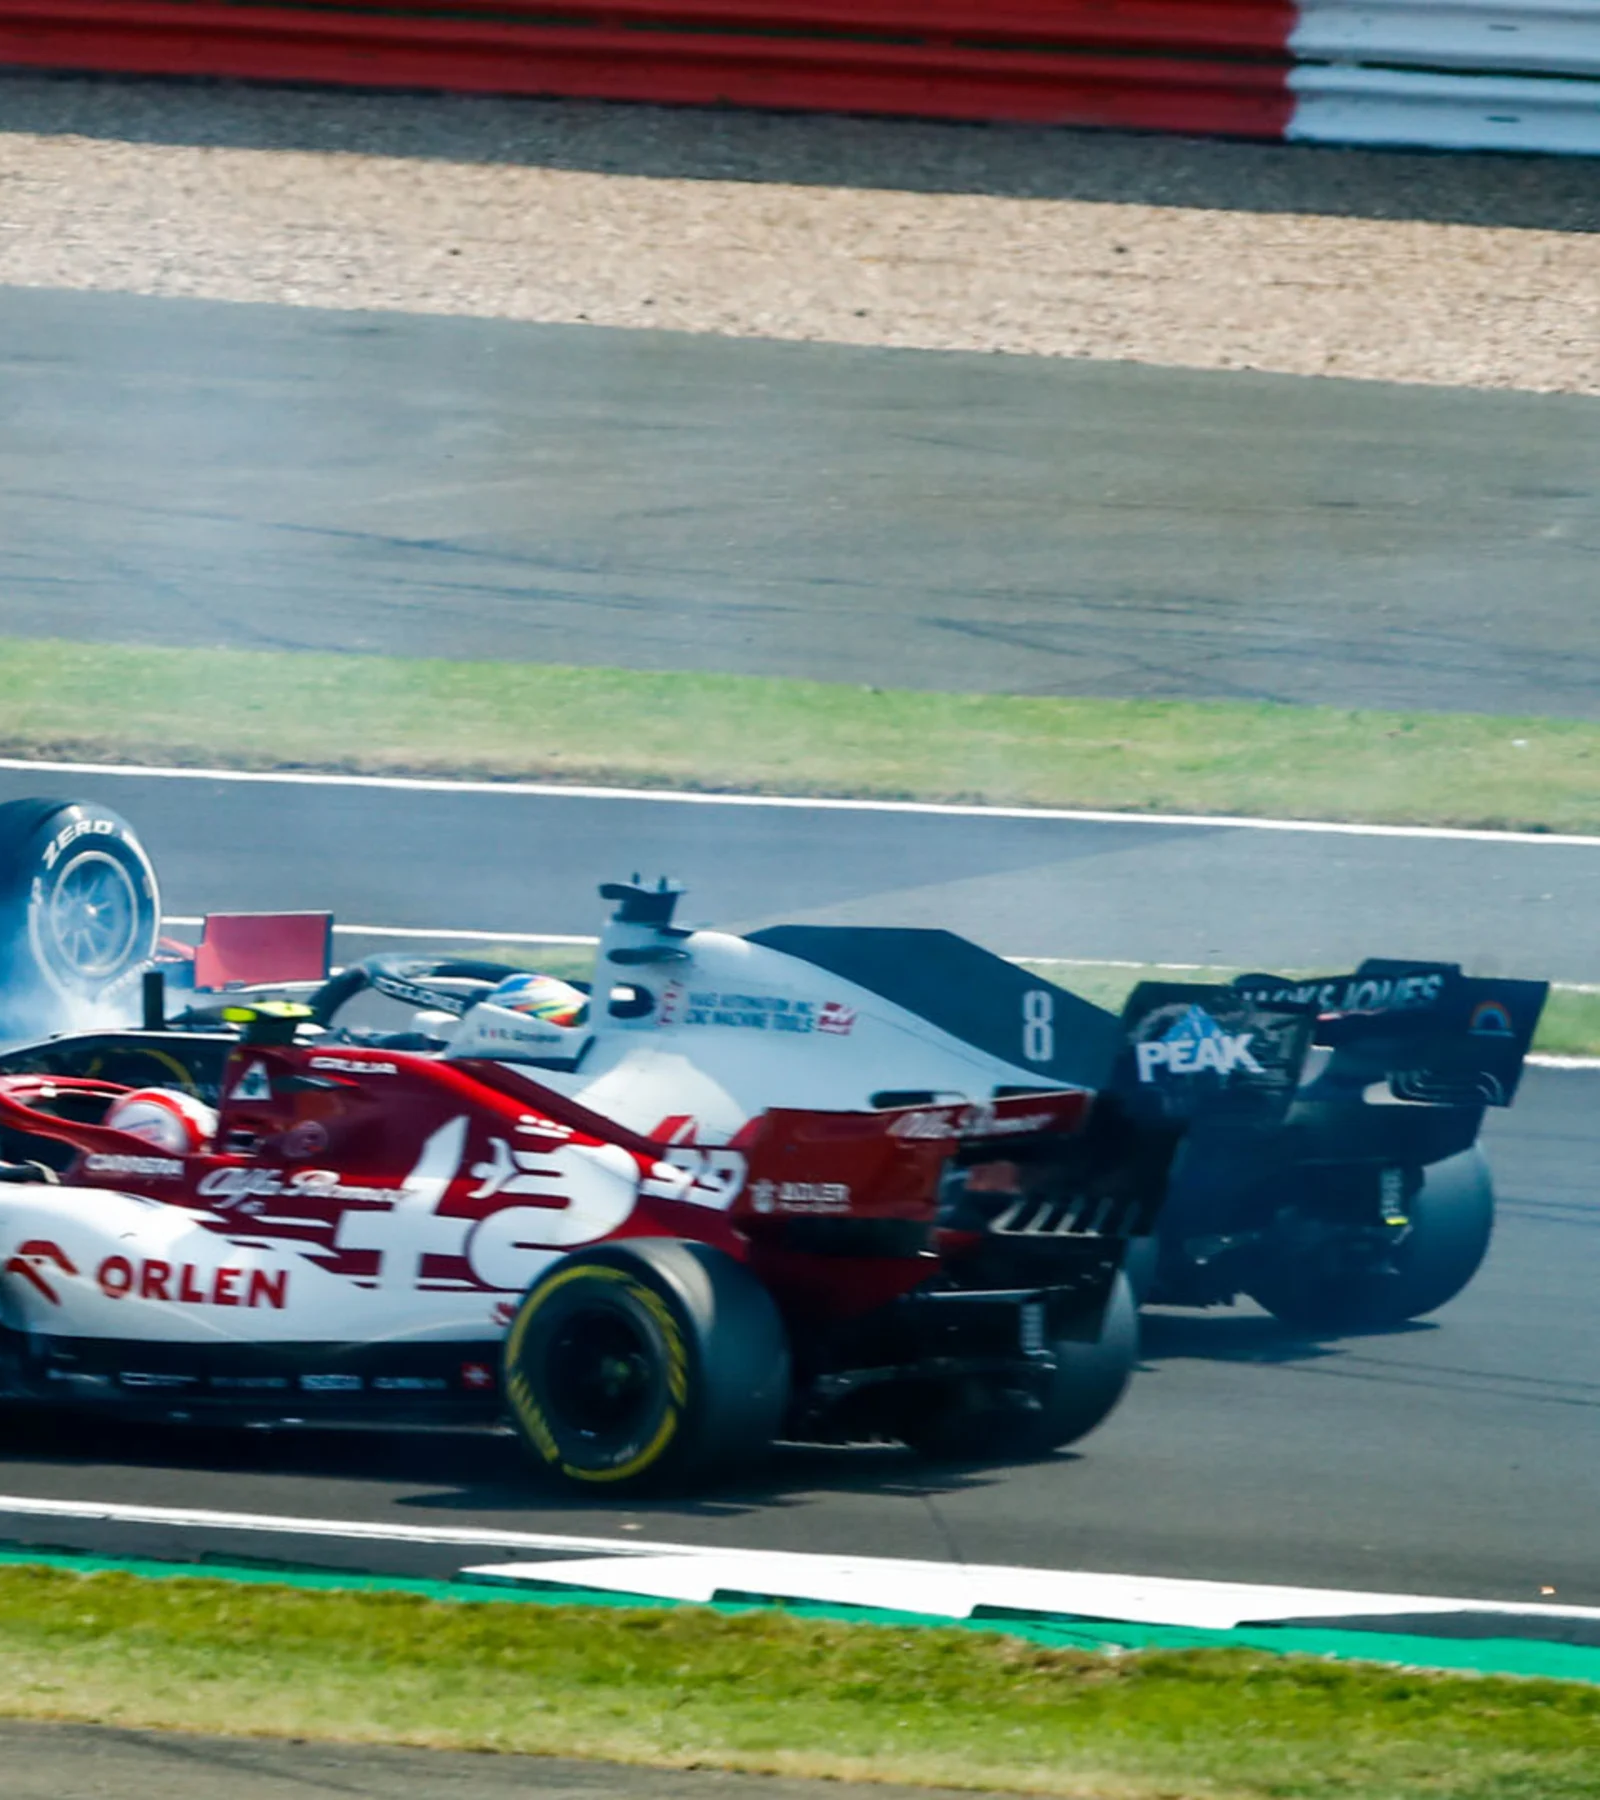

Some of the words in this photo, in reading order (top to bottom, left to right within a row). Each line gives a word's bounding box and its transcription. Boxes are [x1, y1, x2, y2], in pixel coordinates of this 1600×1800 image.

[41, 819, 116, 871] ZERO
[1022, 989, 1054, 1062] 8
[1135, 1031, 1267, 1084] PEAK
[96, 1255, 290, 1310] ORLEN
